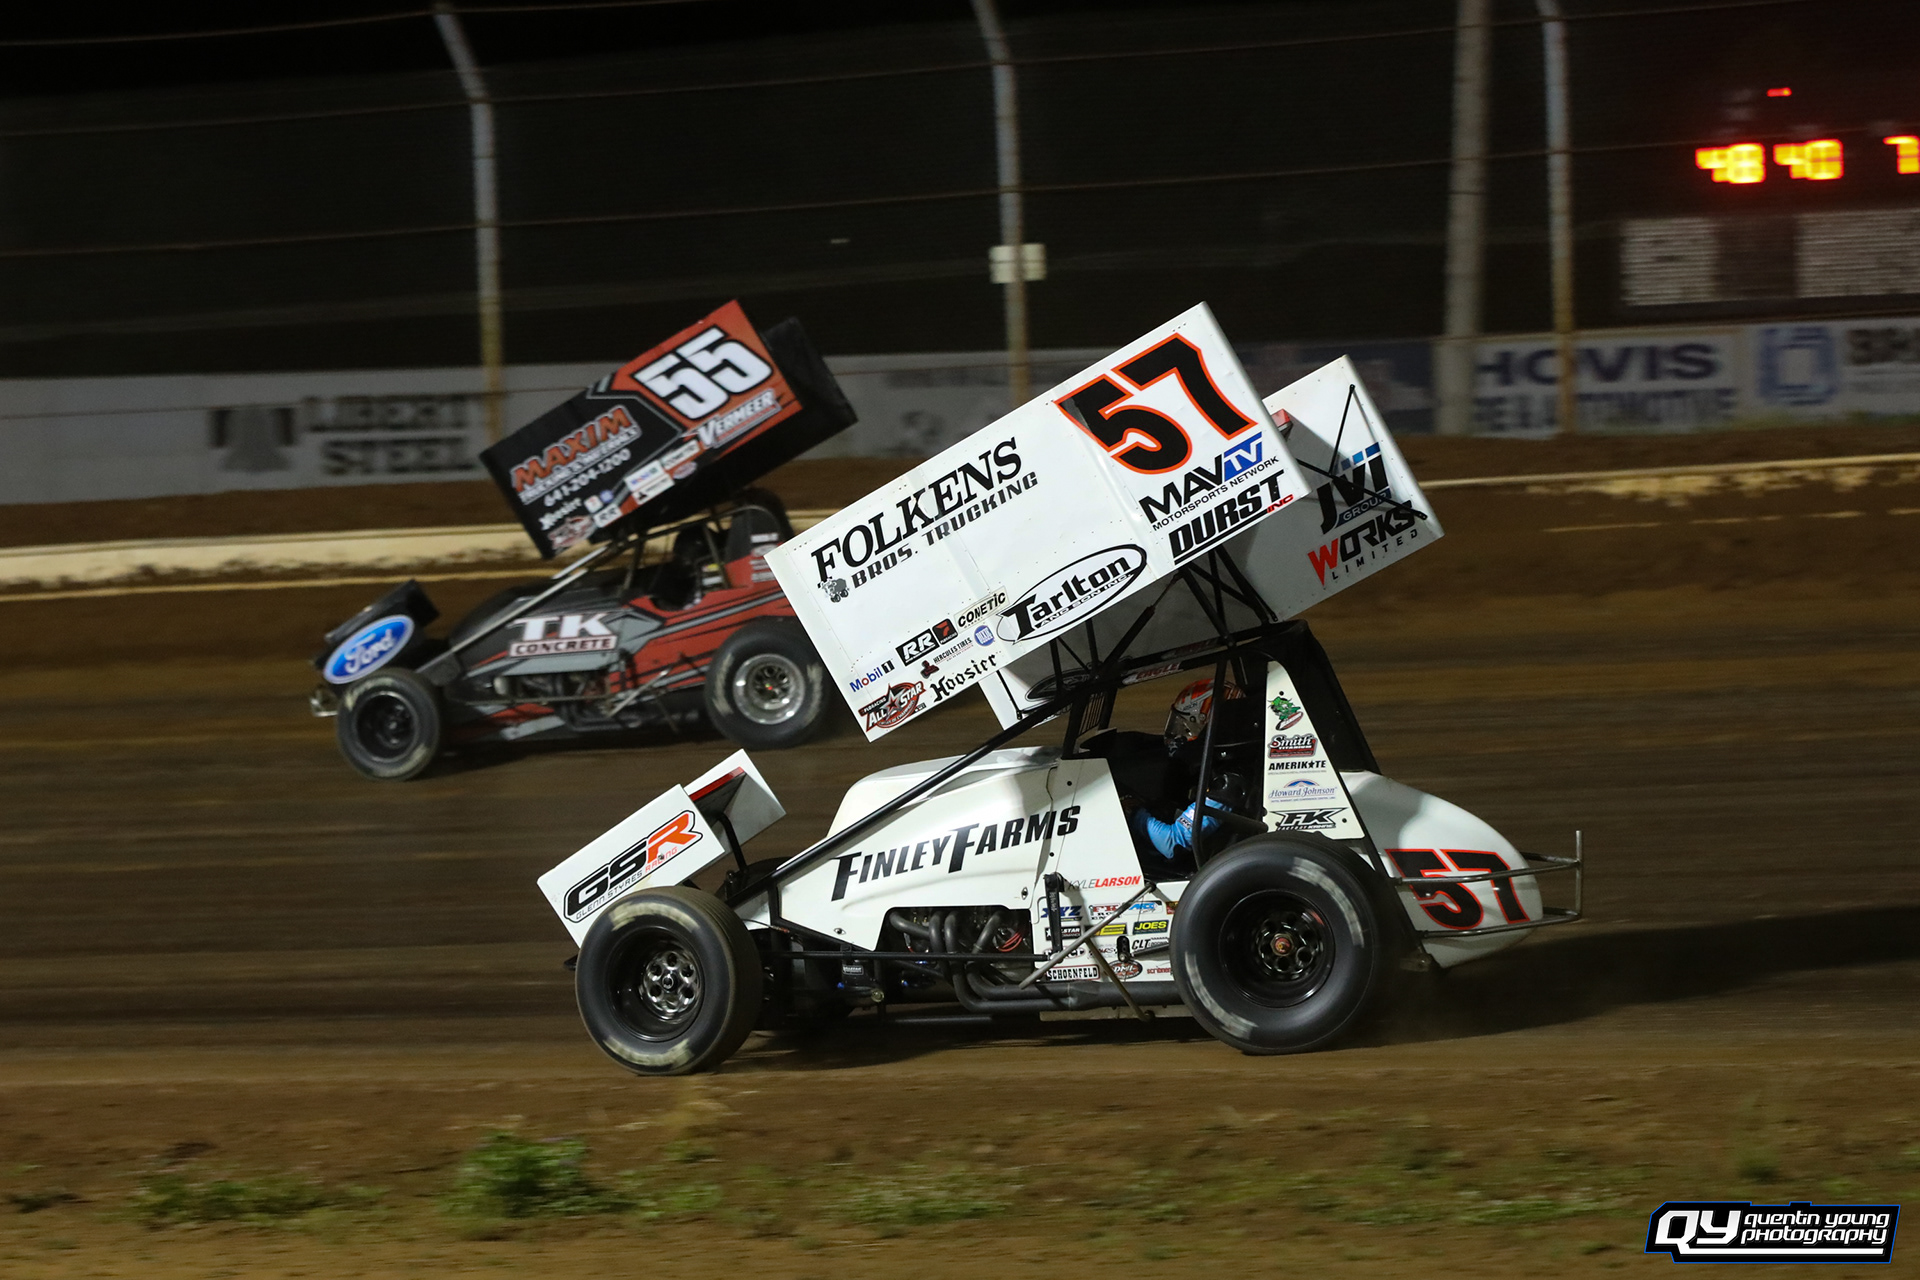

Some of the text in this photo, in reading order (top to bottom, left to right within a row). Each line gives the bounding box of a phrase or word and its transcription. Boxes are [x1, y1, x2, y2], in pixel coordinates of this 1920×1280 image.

[632, 326, 773, 420] 55
[699, 391, 775, 447] VERMEER
[1053, 332, 1259, 475] 57
[512, 406, 633, 492] MAXIM
[811, 437, 1022, 588] FOLKENS
[1152, 455, 1279, 532] MOTORSPORTS NETWORK
[1168, 469, 1294, 558] DURST INC
[851, 471, 1038, 589] BROS. TRUCKING
[1307, 500, 1415, 587] WORKS
[1332, 529, 1417, 580] LIMITED
[958, 592, 1006, 627] CONETIC
[1001, 556, 1131, 640] Tarlton
[1041, 606, 1070, 627] AND
[1072, 590, 1101, 609] SON
[510, 613, 613, 641] TK
[515, 639, 612, 655] CONCRETE
[902, 632, 935, 660] RR
[933, 645, 958, 664] HERCULES
[956, 637, 973, 651] TIRES
[344, 628, 396, 674] Ford
[849, 660, 894, 692] Mobil 1
[930, 655, 996, 702] Hoosier
[868, 709, 888, 728] ALL
[899, 682, 923, 708] STAR
[1270, 734, 1312, 749] Smith
[1269, 786, 1336, 799] Howard Johnson
[948, 805, 1081, 874] FARMS
[1284, 810, 1330, 825] FK
[567, 813, 697, 916] GSR
[576, 896, 605, 920] GLENN
[607, 870, 643, 898] STYRES
[1384, 849, 1530, 930] 57
[1131, 939, 1151, 950] CLT
[1134, 921, 1167, 930] JOES
[1047, 967, 1099, 979] SCHOENFELD
